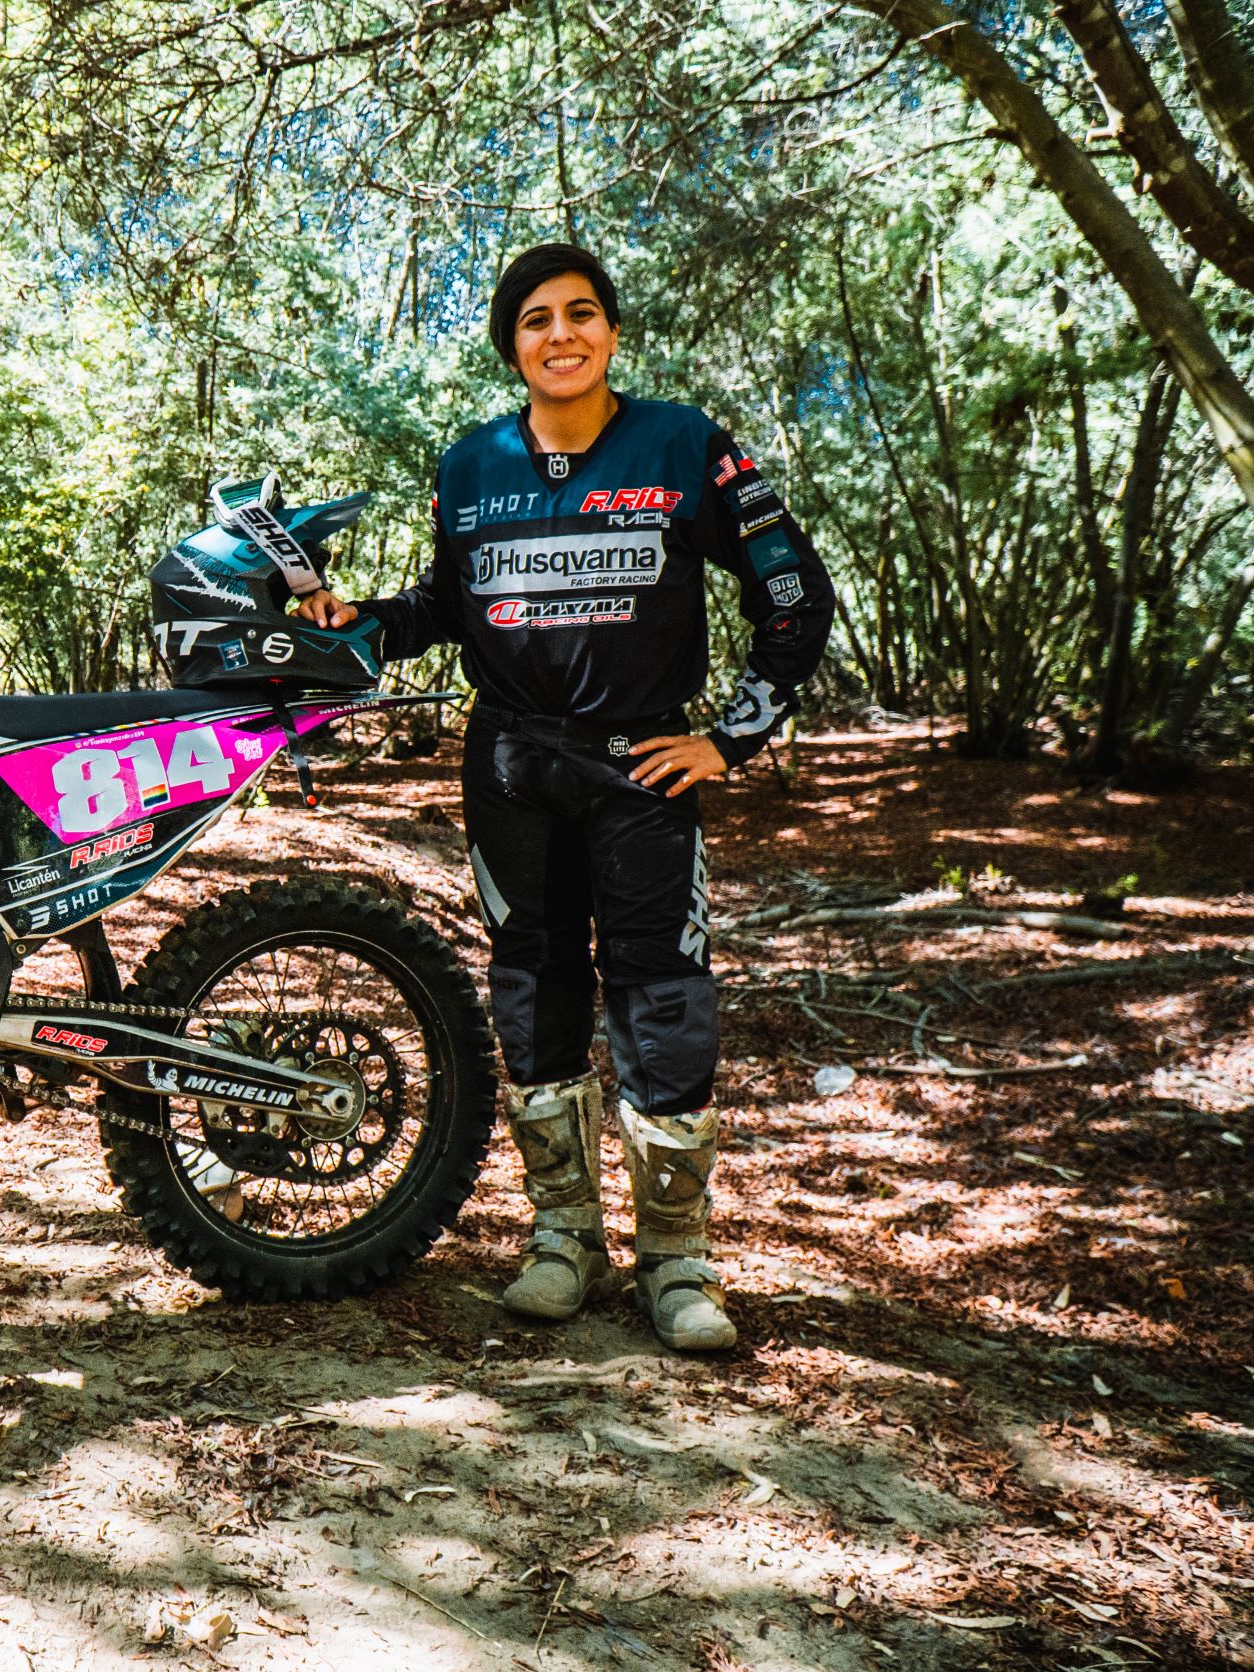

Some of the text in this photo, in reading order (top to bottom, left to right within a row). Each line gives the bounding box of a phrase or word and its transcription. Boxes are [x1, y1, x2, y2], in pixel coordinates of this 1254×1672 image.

[579, 486, 683, 513] R.RIOS
[241, 507, 311, 572] SHOT
[496, 547, 656, 577] Husqvarna
[570, 573, 656, 587] FACTORY RACING
[770, 575, 796, 593] BIG
[520, 597, 635, 616] MAXIMA
[774, 585, 802, 604] MOTO
[530, 614, 632, 628] RACING OILS
[52, 726, 234, 833] 814
[69, 823, 155, 869] R.RIOS
[8, 868, 61, 894] Licantén
[56, 883, 113, 915] SHOT
[678, 827, 710, 966] SHOT
[36, 1025, 108, 1053] R.RIOS
[183, 1074, 295, 1107] MICHELIN
